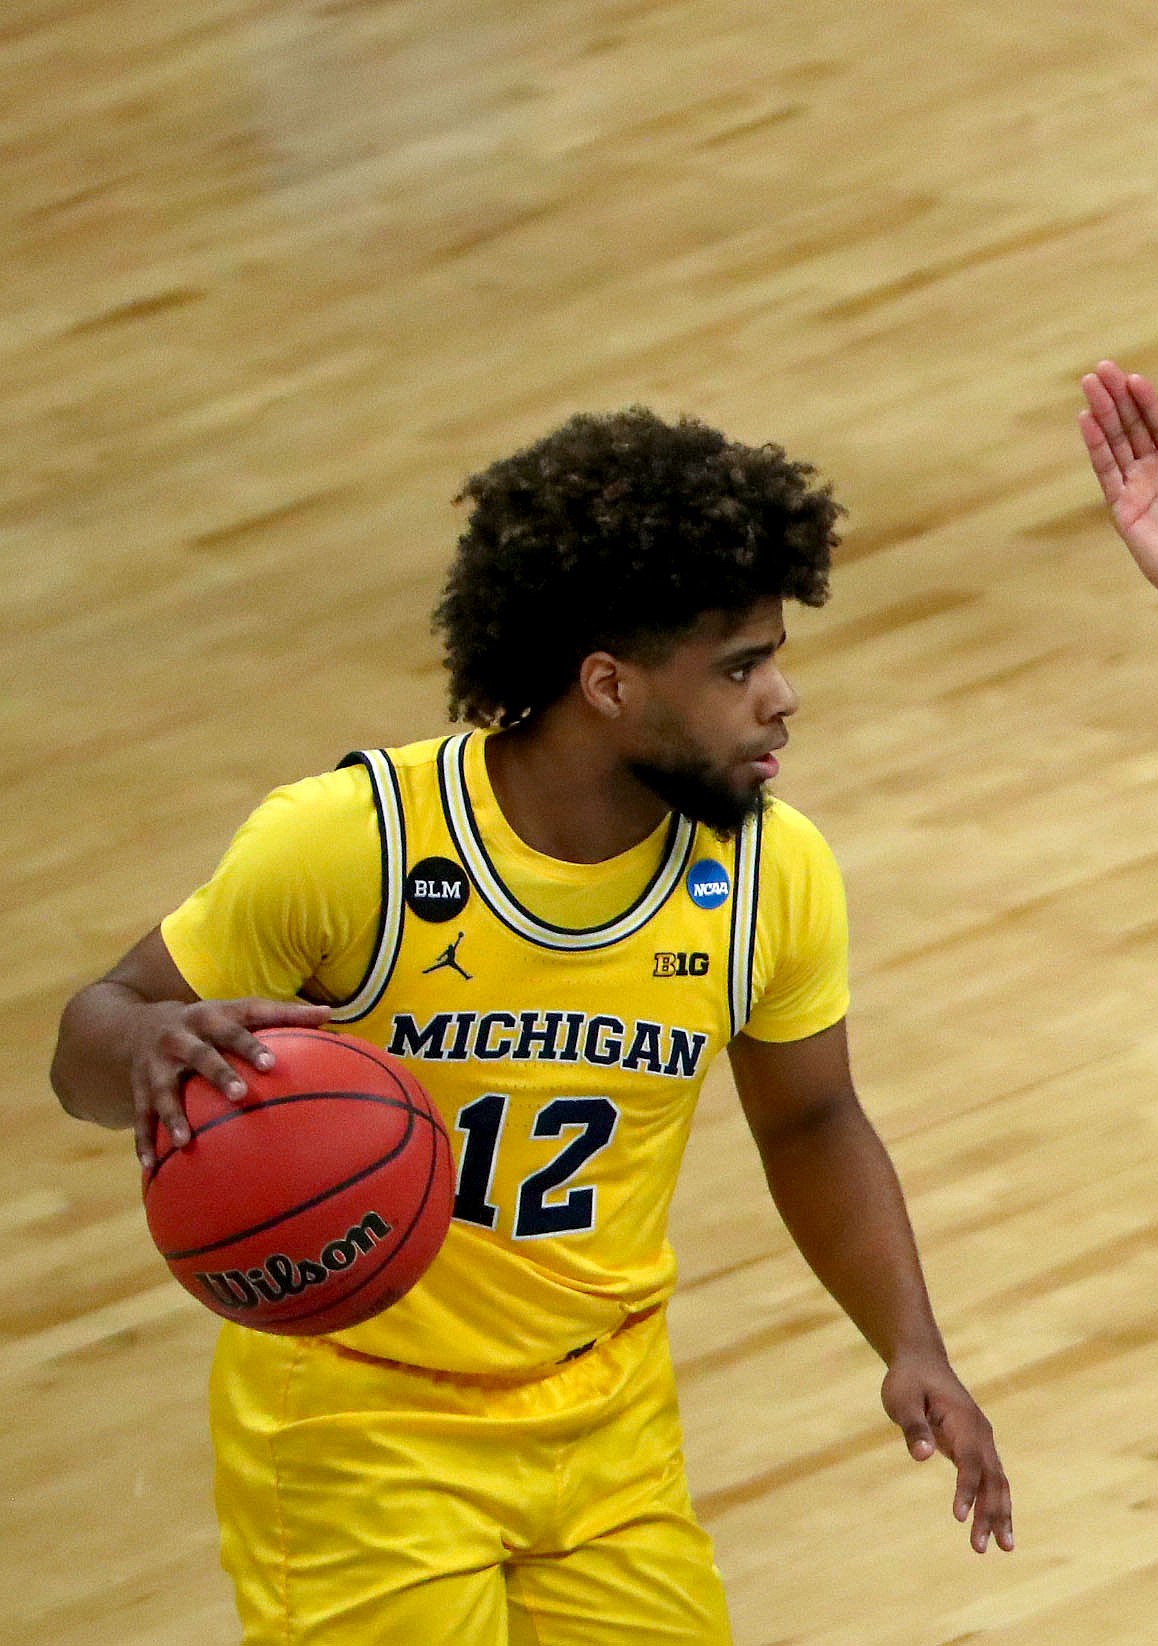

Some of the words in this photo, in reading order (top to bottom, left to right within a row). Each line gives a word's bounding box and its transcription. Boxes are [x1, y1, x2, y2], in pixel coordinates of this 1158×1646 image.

[414, 879, 461, 900] BLM
[693, 882, 729, 897] NCAA
[387, 1010, 709, 1080] MICHIGAN
[451, 1092, 620, 1241] 12
[193, 1210, 394, 1310] Wilson
